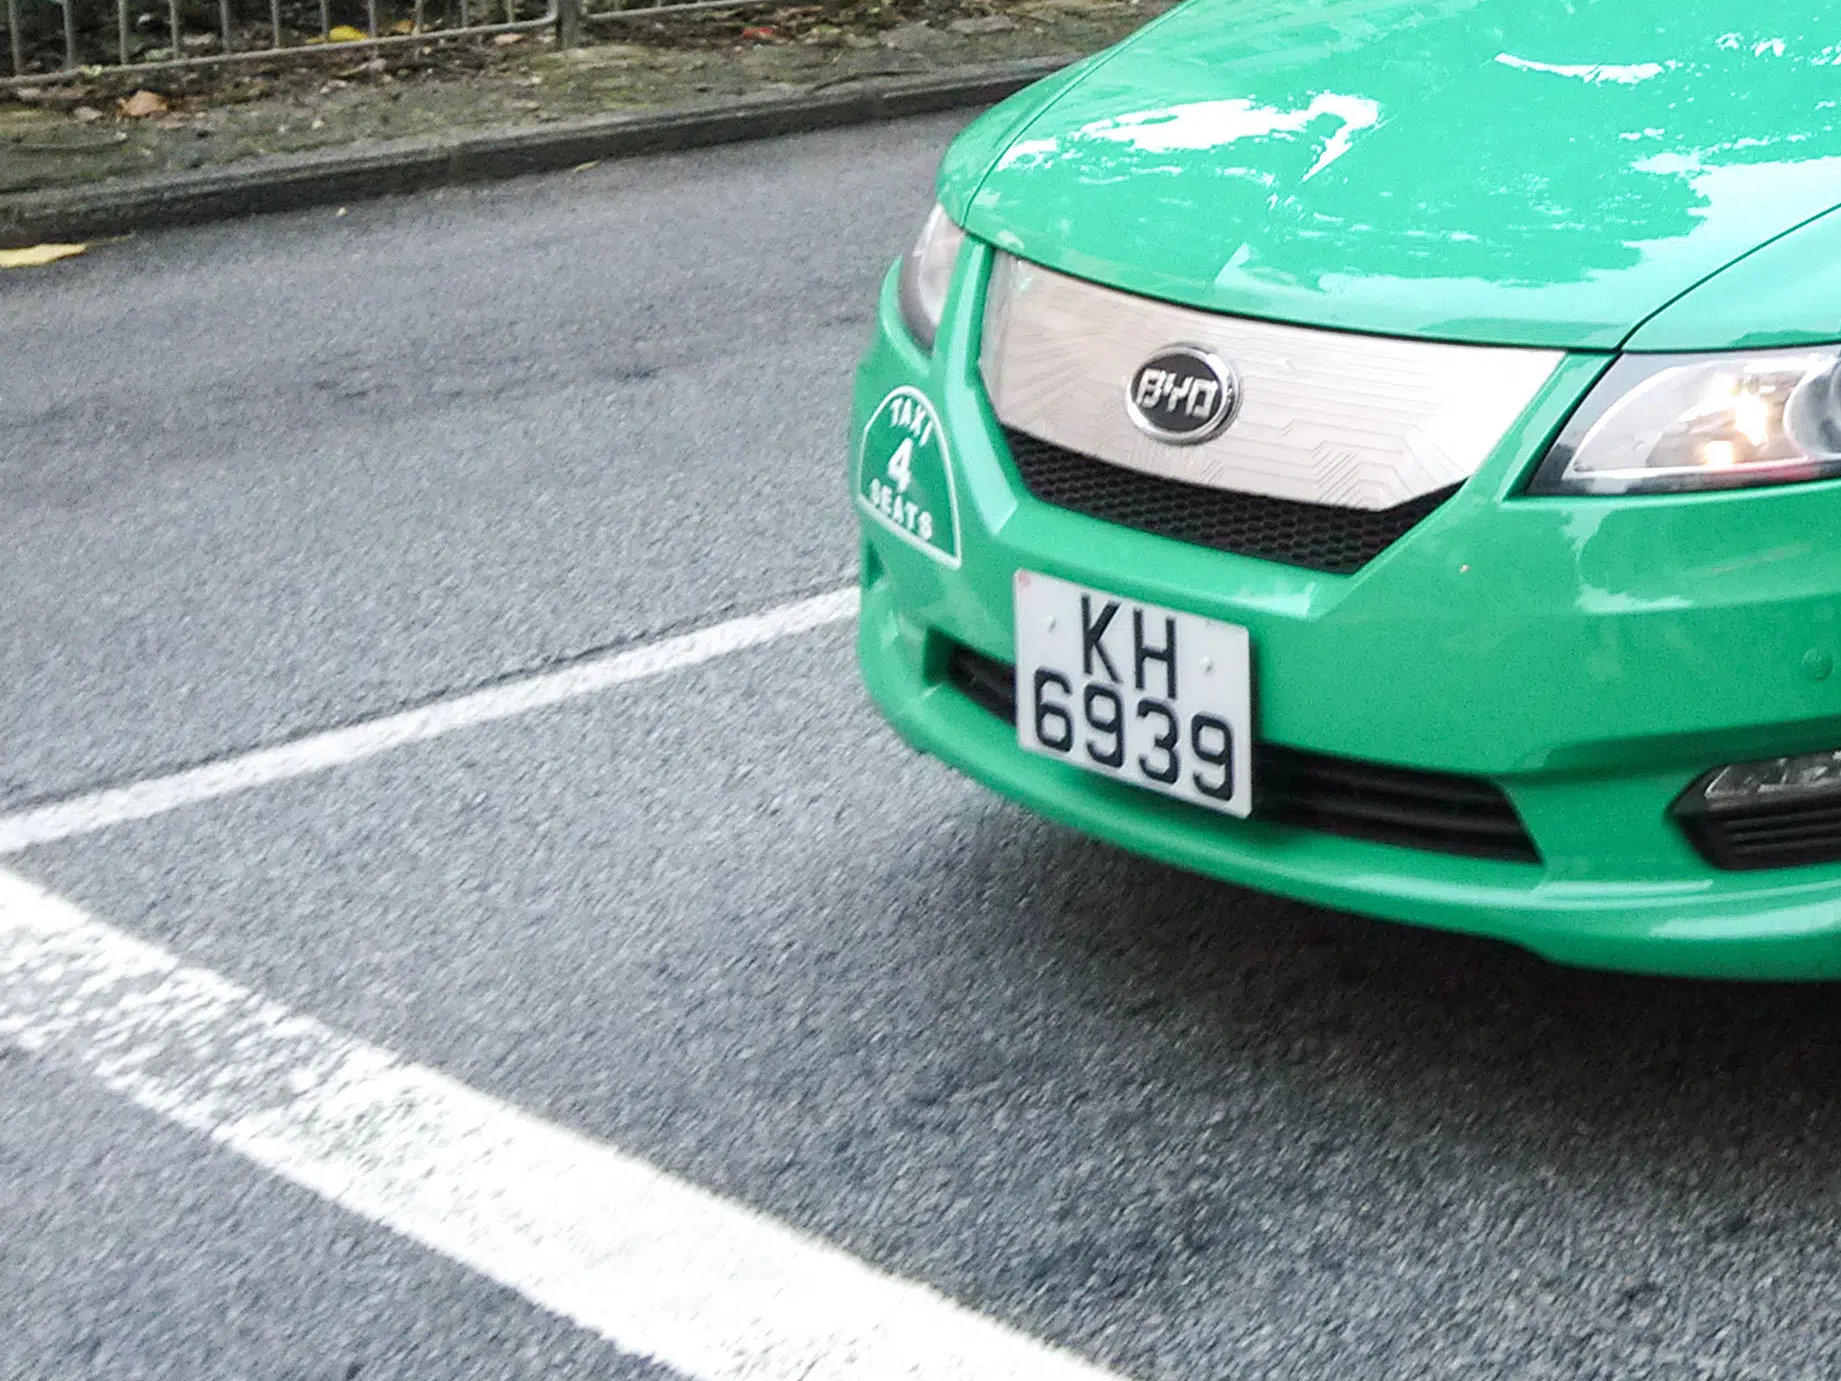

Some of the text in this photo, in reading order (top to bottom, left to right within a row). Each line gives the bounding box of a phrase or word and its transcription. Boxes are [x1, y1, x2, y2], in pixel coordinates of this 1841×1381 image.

[889, 397, 934, 447] TAXI
[1135, 368, 1219, 418] BYD
[887, 437, 914, 494] 4
[870, 478, 932, 541] SEATS
[1080, 593, 1177, 700] KH
[1033, 666, 1235, 802] 6939
